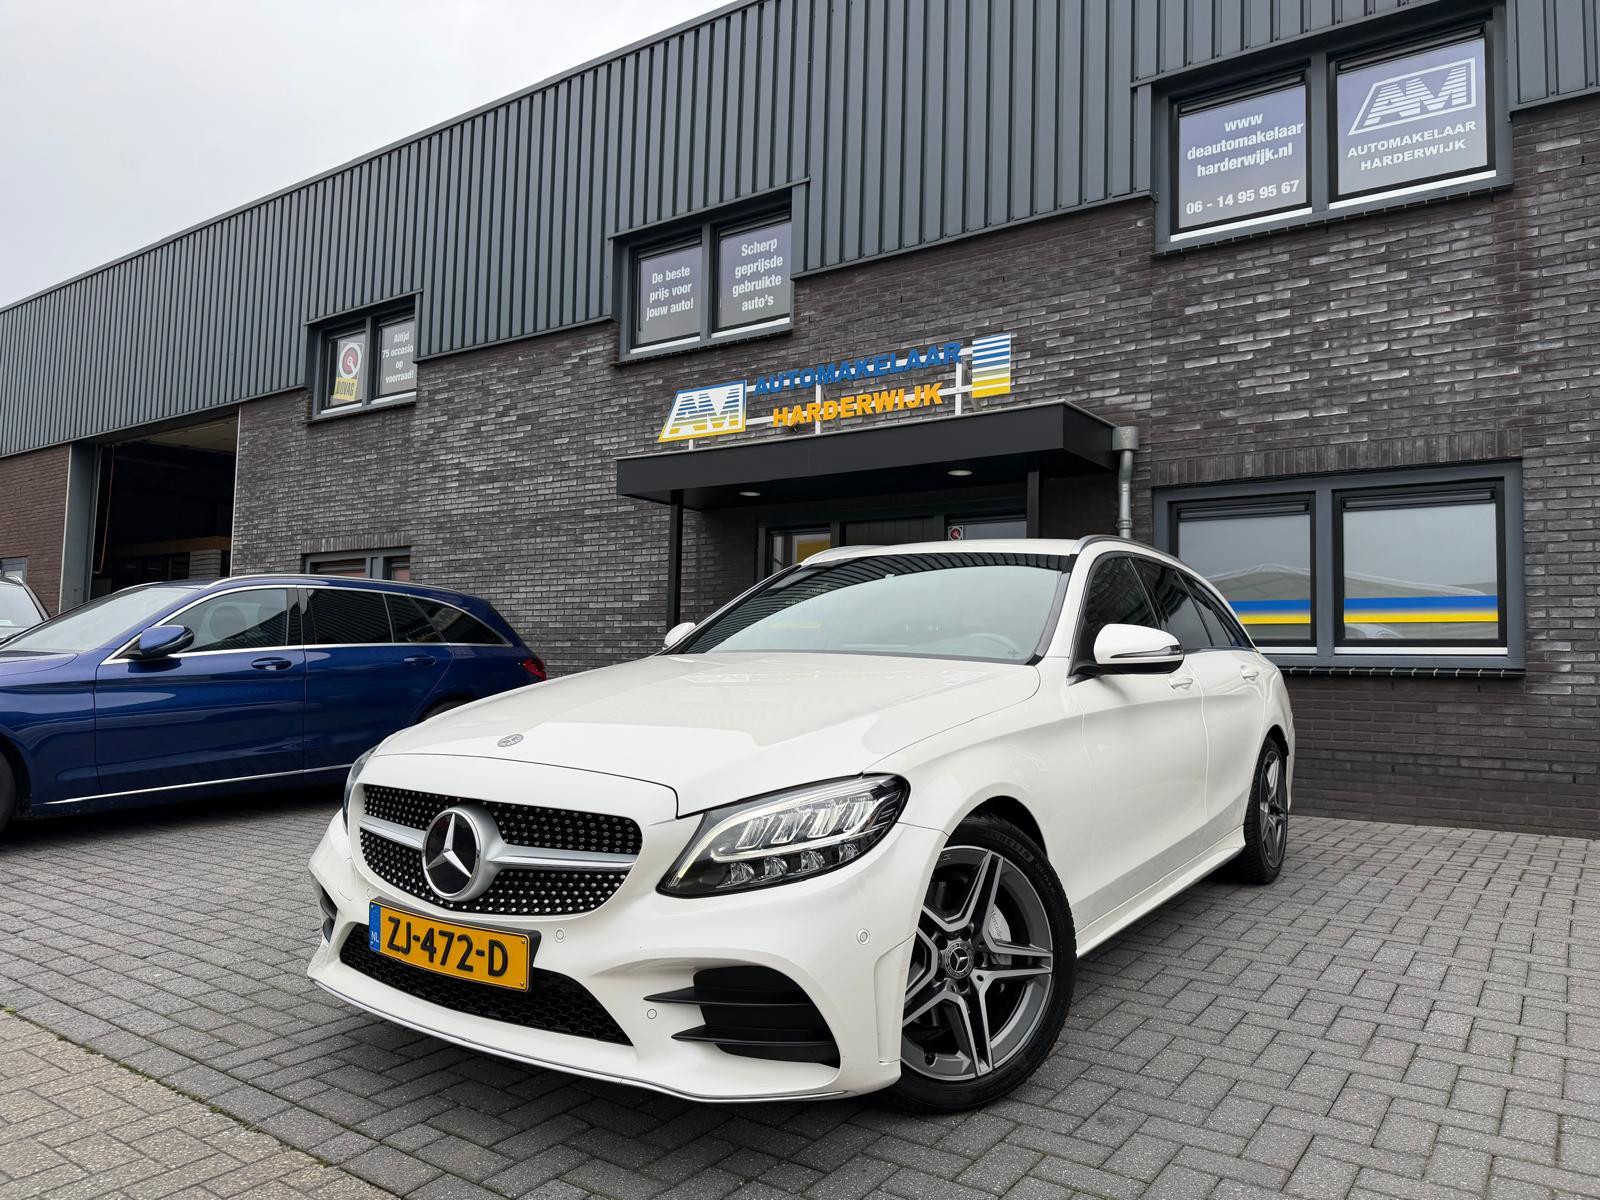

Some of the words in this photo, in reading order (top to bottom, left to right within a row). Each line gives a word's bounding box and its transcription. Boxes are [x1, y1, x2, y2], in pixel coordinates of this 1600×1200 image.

[1224, 113, 1264, 132] www
[1187, 121, 1304, 161] deautomakelaar
[1347, 120, 1477, 159] AUTOMAKELAAR
[1197, 143, 1293, 178] harderwijk.nl
[1360, 138, 1466, 171] HARDERWIJK
[1186, 201, 1203, 216] 06
[1217, 193, 1235, 209] 14
[1237, 189, 1256, 204] 95
[1259, 184, 1277, 200] 95
[1281, 179, 1300, 195] 67
[741, 238, 778, 257] Scherp
[652, 272, 664, 284] De
[666, 266, 691, 281] beste
[735, 255, 783, 278] geprijsde
[649, 287, 669, 303] prijs
[671, 283, 692, 297] voor
[732, 274, 782, 297] gebruikte
[646, 304, 668, 321] jouw
[670, 298, 694, 313] auto!
[742, 294, 774, 311] auto's
[382, 349, 390, 358] 75
[396, 361, 404, 370] op
[754, 341, 962, 397] AUTOMAKELAAR
[385, 371, 414, 384] voorraad!
[772, 382, 943, 428] HARDERWIJK
[371, 931, 379, 943] NL
[387, 916, 509, 977] ZJ-472-D
